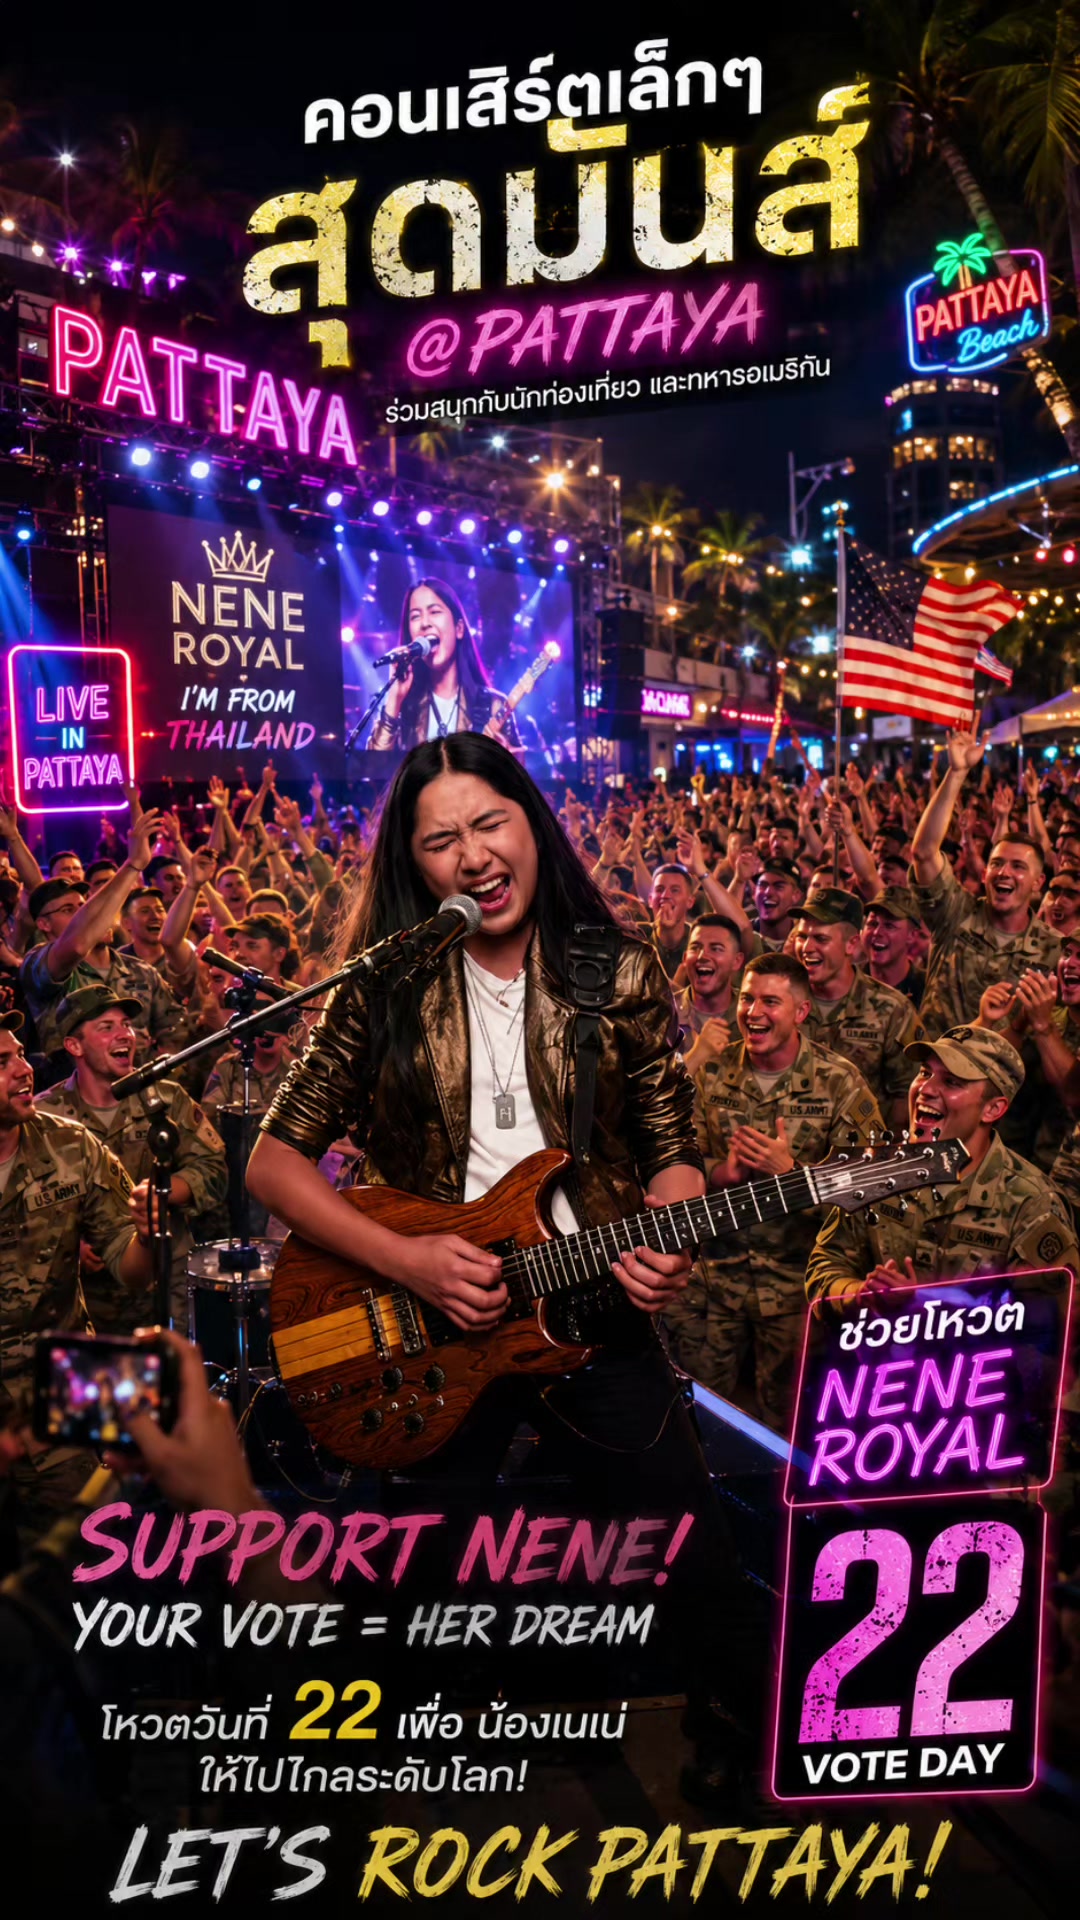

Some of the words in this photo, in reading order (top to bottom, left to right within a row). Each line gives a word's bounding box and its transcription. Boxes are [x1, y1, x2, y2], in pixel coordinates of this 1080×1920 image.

[915, 269, 1039, 342] PATTAYA
[957, 308, 1040, 364] Beach
[54, 304, 358, 466] PATTAYA
[171, 581, 305, 633] NENE
[173, 632, 304, 670] ROYAL
[36, 685, 110, 723] LIVE
[181, 686, 219, 713] I'M
[227, 687, 295, 713] FROM
[62, 727, 84, 749] IN
[166, 719, 315, 750] THAILAND
[23, 753, 124, 790] PATTAYA
